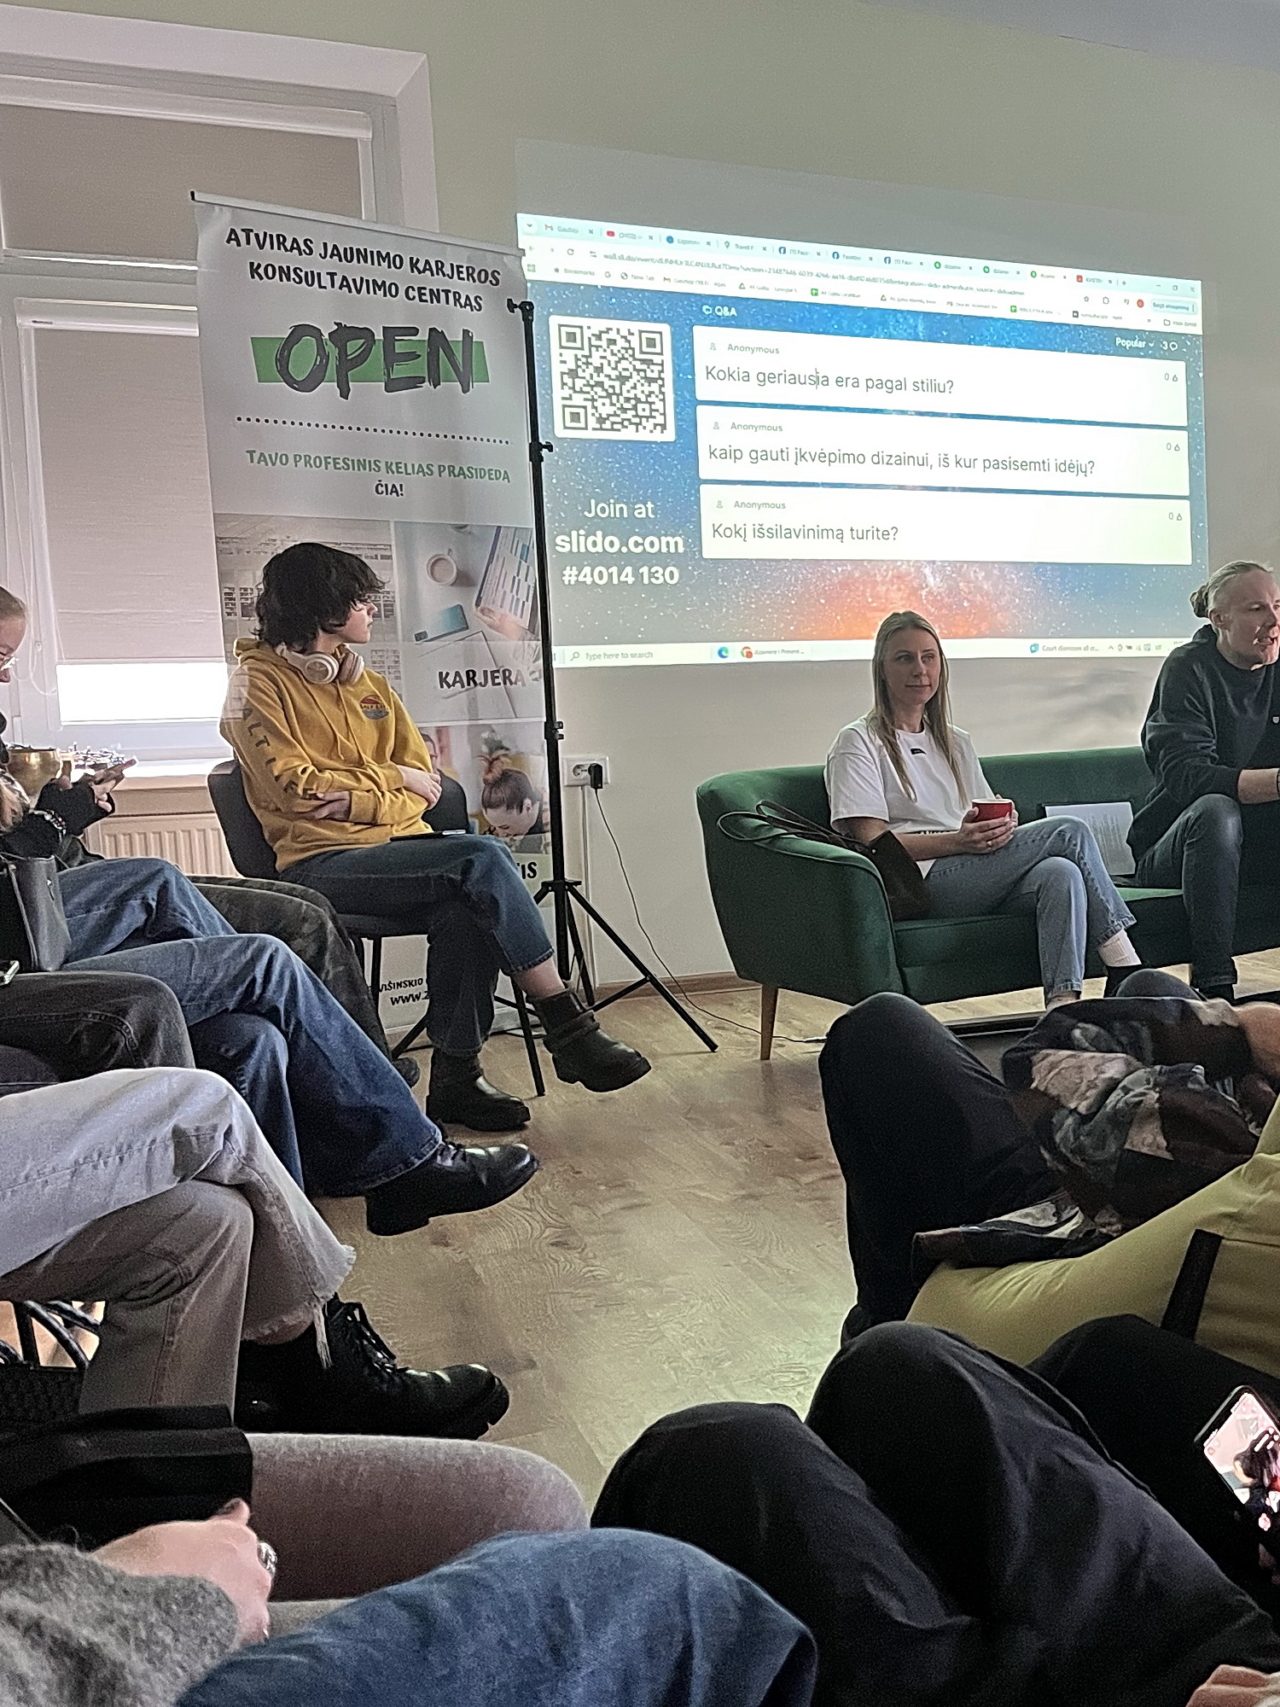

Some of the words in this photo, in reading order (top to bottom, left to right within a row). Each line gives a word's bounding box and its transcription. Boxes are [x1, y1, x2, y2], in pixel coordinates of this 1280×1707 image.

[225, 227, 315, 256] ATVIRAS
[319, 241, 404, 270] JAUNIMO
[409, 256, 502, 287] KARJEROS
[248, 261, 400, 299] KONSULTAVIMO
[404, 285, 483, 312] CENTRAS
[715, 305, 737, 318] Q&A
[727, 342, 780, 356] Anonymous
[1115, 337, 1146, 350] Popular
[275, 321, 474, 401] OPEN
[705, 365, 751, 383] Kokia
[756, 368, 830, 389] geriausia
[835, 376, 861, 389] era
[865, 376, 907, 394] pagal
[912, 376, 955, 395] stiliu?
[730, 421, 783, 434] Anonymous
[246, 449, 290, 467] TAVO
[293, 453, 382, 474] PROFESINIS
[385, 461, 434, 478] KELIAS
[437, 464, 511, 484] PRASIDEDA
[708, 444, 744, 464] kaip
[749, 447, 790, 465] gauti
[794, 447, 866, 467] įkvėpimo
[870, 451, 933, 471] dizainui,
[938, 452, 950, 469] iš
[954, 454, 978, 470] kur
[982, 455, 1051, 473] pasisemti
[1054, 459, 1095, 477] idėjų?
[374, 479, 404, 497] ČIA!
[584, 499, 628, 519] Join
[634, 501, 655, 519] at
[733, 500, 786, 511] Anonymous
[555, 531, 685, 554] slido.com
[712, 523, 748, 543] Kokį
[753, 523, 844, 544] išsilavinimą
[850, 526, 899, 542] turite?
[562, 566, 635, 586] #4014
[642, 566, 680, 585] 130
[585, 651, 601, 662] Type
[602, 651, 619, 660] here
[621, 652, 629, 660] to
[630, 650, 654, 660] search
[438, 668, 526, 690] KARJERA
